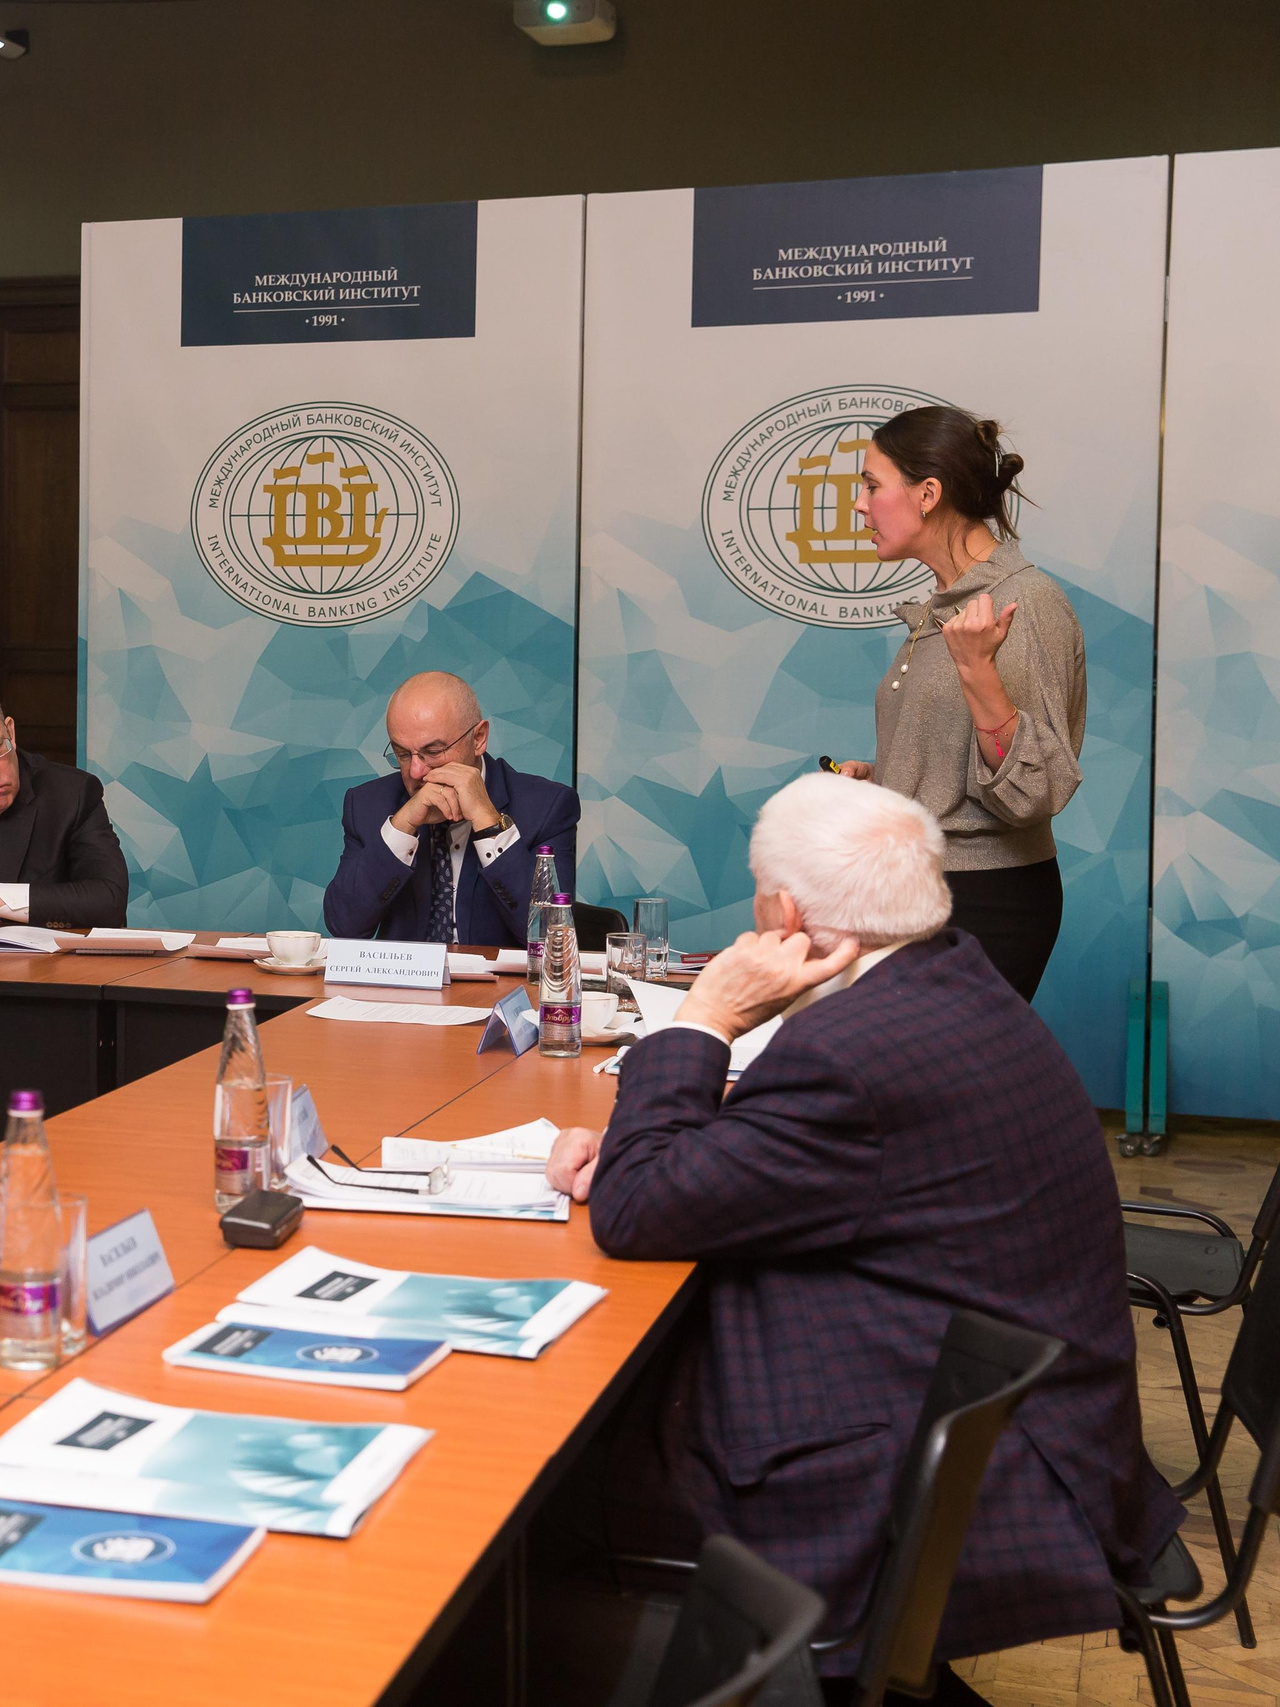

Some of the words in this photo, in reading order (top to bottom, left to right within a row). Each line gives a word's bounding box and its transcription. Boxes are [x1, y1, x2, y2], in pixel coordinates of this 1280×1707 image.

[778, 237, 947, 261] МЕЖДУНАРОДНЫЙ
[254, 267, 398, 287] МЕЖДУНАРОДНЫЙ
[752, 258, 873, 281] БАНКОВСКИЙ
[877, 256, 974, 275] ИНСТИТУТ
[232, 286, 335, 304] БАНКОВСКИЙ
[339, 286, 421, 301] ИНСТИТУТ
[844, 290, 877, 304] 1991
[312, 314, 339, 327] 1991
[208, 413, 301, 508] МЕЖДУНАРОДНЫЙ
[306, 413, 400, 443] БАНКОВСКИЙ
[399, 439, 442, 507] ИНСТИТУТ
[722, 398, 832, 502] МЕЖДУНАРОДНЫЙ
[207, 534, 300, 616] INTERNATIONAL
[307, 597, 378, 618] BANKING
[382, 532, 442, 602] INSTITUTE
[721, 529, 828, 617] INTERNATIONAL
[359, 951, 413, 961] ВАСИЛЬЕВ
[329, 964, 362, 973] СЕРГЕЙ
[365, 967, 439, 978] АЛЕКСАНДРОВИЧ
